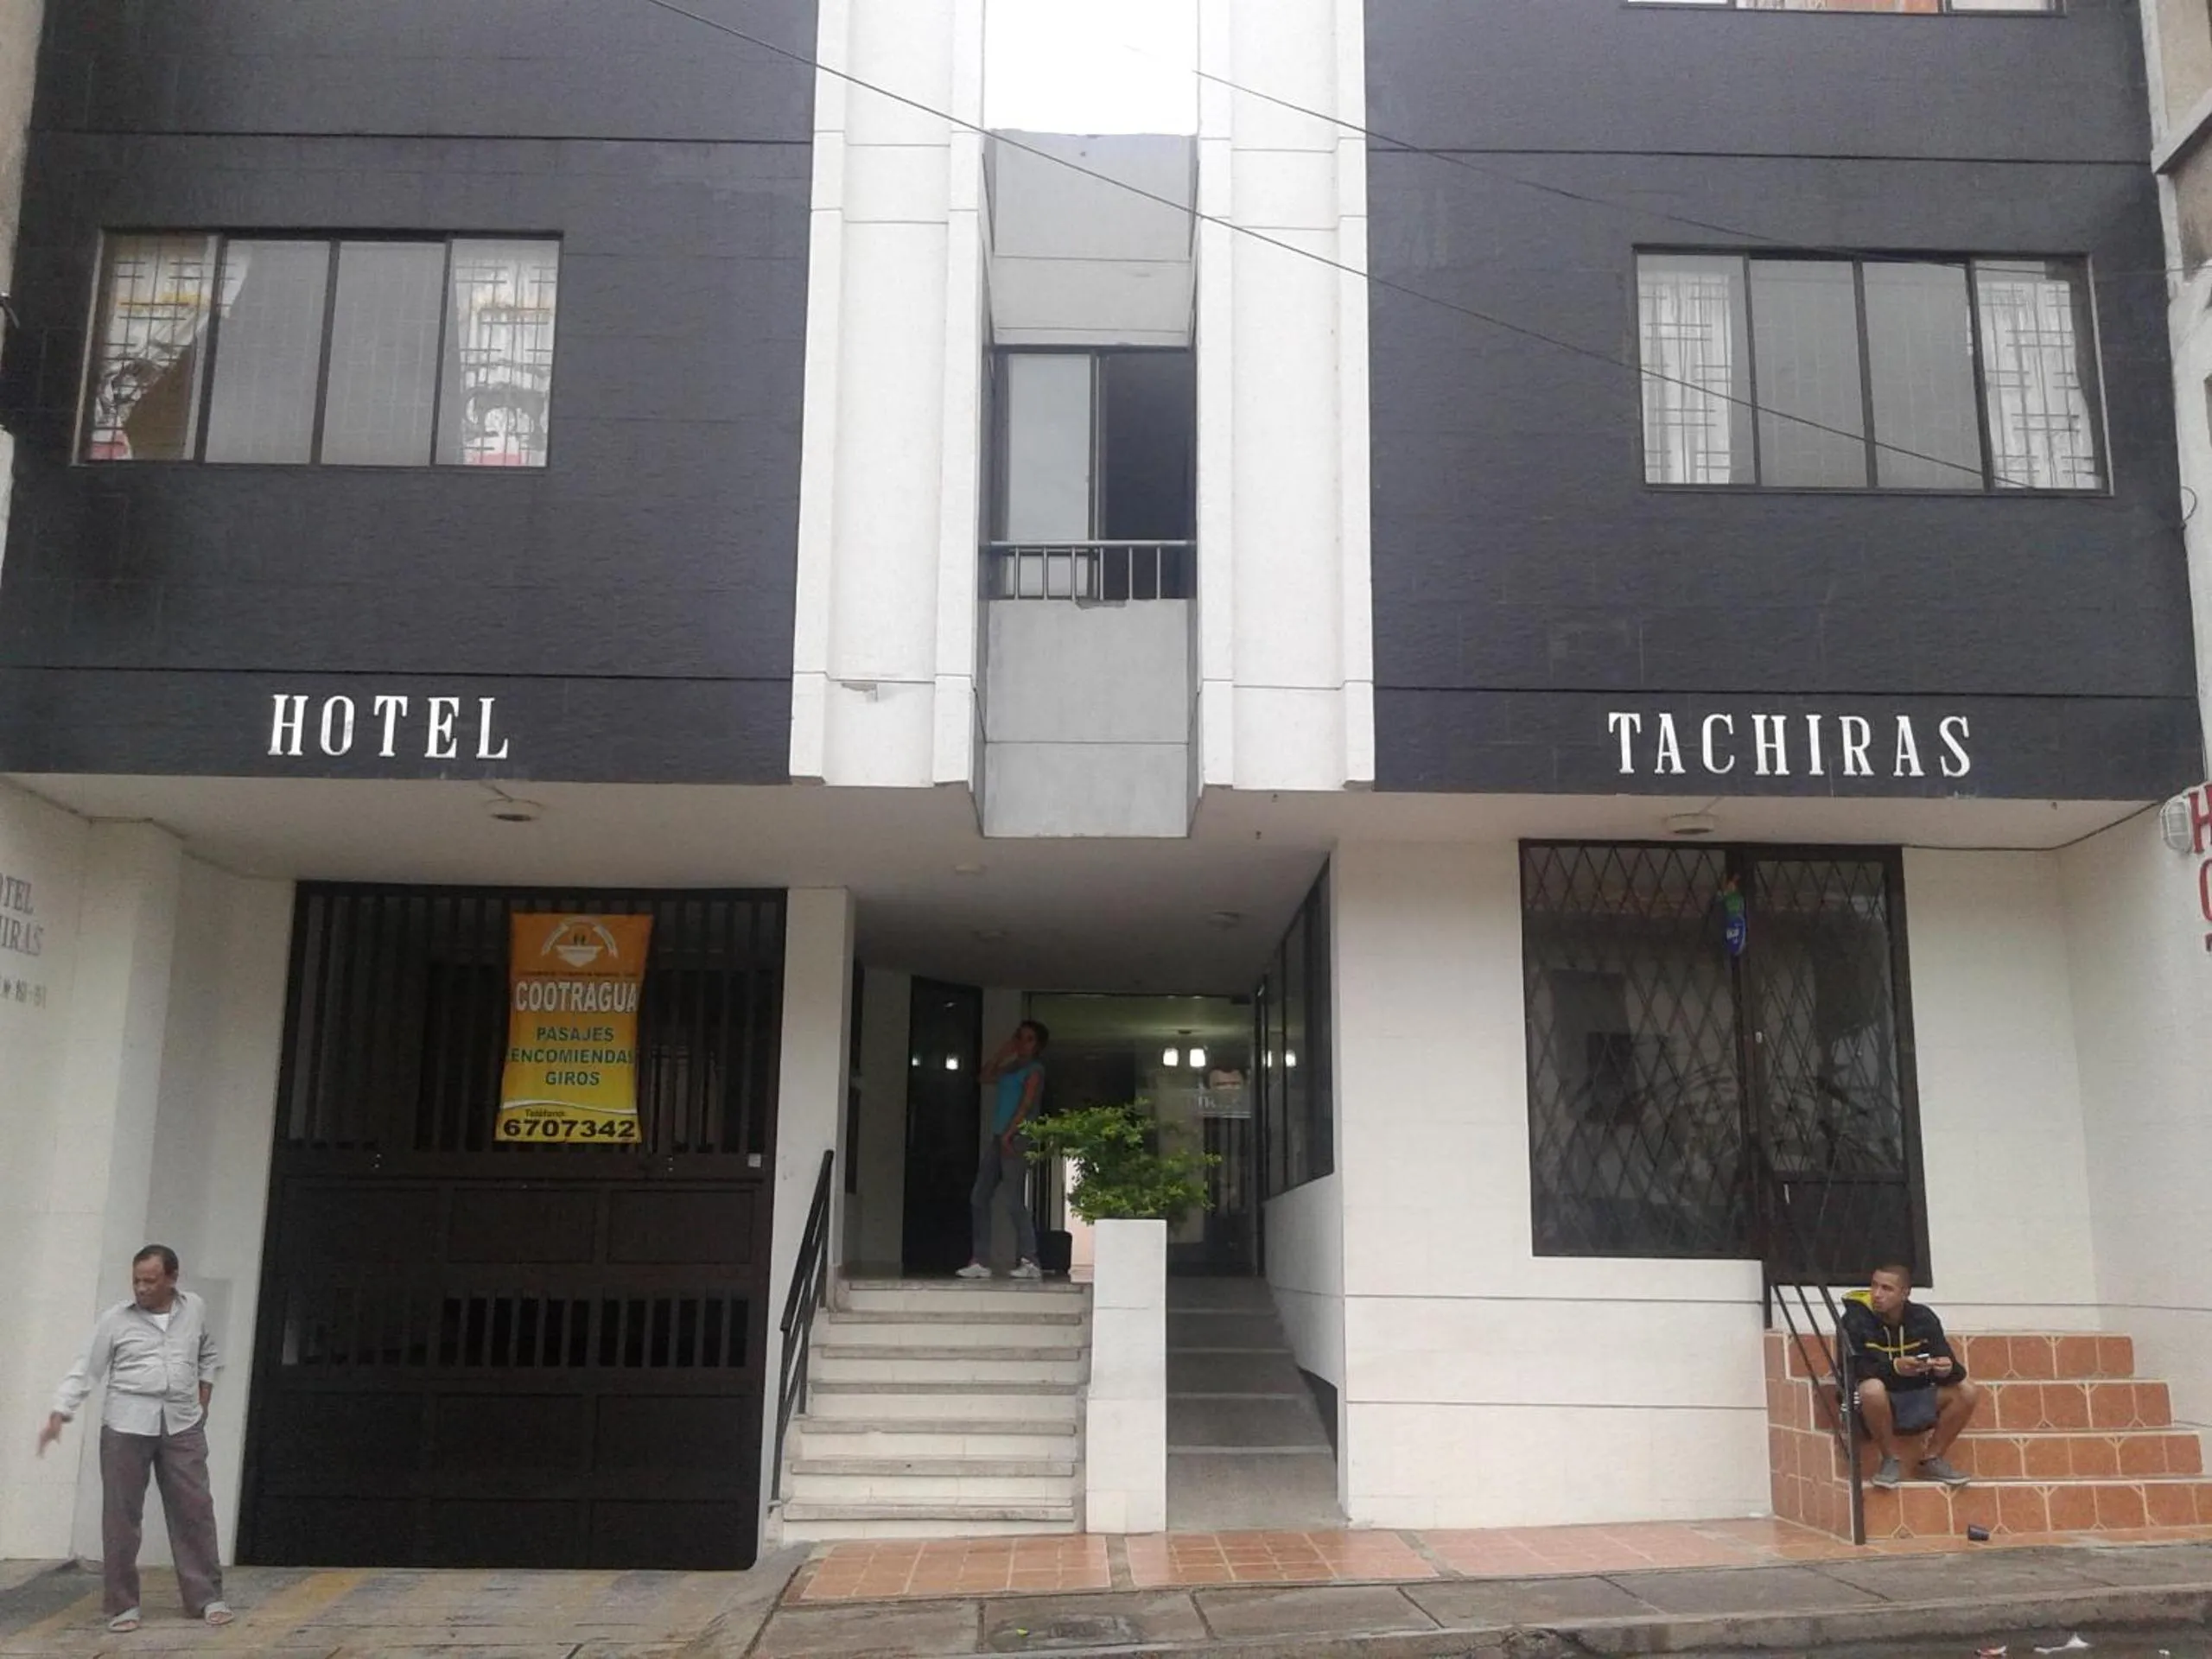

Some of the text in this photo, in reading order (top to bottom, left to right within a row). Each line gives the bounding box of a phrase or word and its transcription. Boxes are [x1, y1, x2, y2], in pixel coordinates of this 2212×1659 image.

[267, 694, 509, 760] HOTEL
[1607, 711, 1972, 778] TACHIRAS
[515, 982, 639, 1013] COOTRAGUA
[537, 1027, 614, 1041] PASAJES
[545, 1071, 600, 1086] GIROS
[504, 1120, 636, 1138] 6707342
